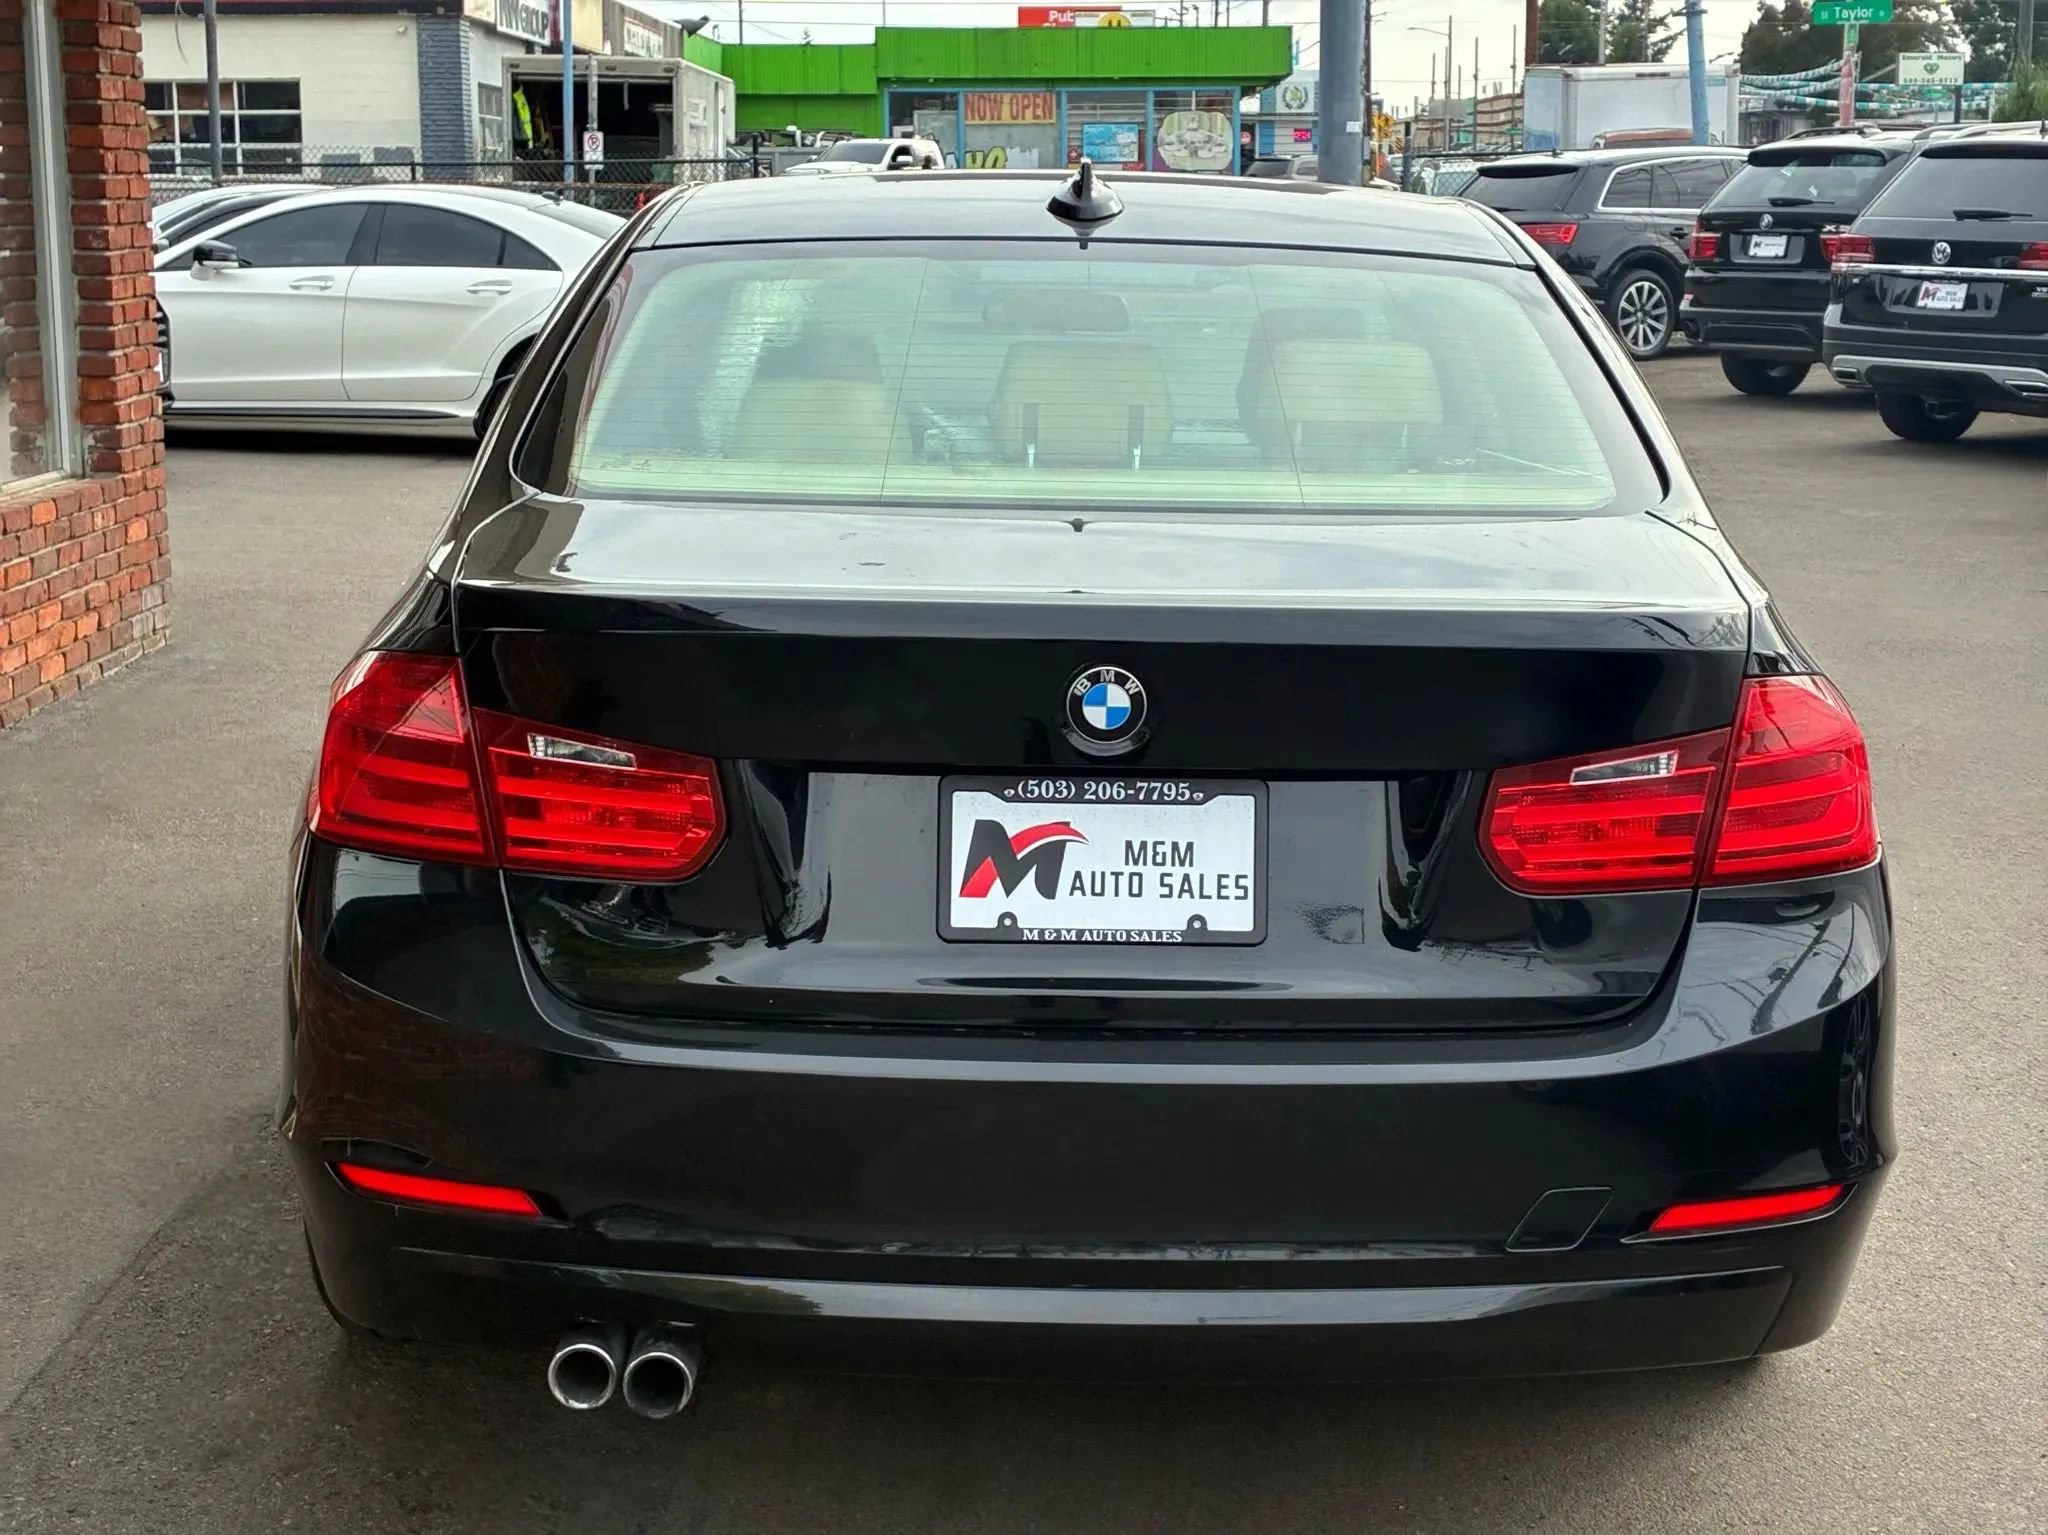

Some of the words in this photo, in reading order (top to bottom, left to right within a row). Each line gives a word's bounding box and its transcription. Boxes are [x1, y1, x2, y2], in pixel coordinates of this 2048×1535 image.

[1833, 6, 1874, 20] Taylor
[965, 94, 1003, 121] NOW
[1010, 93, 1053, 120] OPEN
[1073, 669, 1141, 697] BMW
[1017, 779, 1076, 800] (503)
[1084, 781, 1191, 802] 206-7795
[1124, 839, 1195, 868] M&M
[1068, 870, 1144, 898] AUTO
[1158, 872, 1250, 901] SALES
[1022, 929, 1040, 942] M
[1060, 929, 1078, 942] M
[1081, 929, 1128, 942] AUTO
[1130, 930, 1183, 943] SALES
